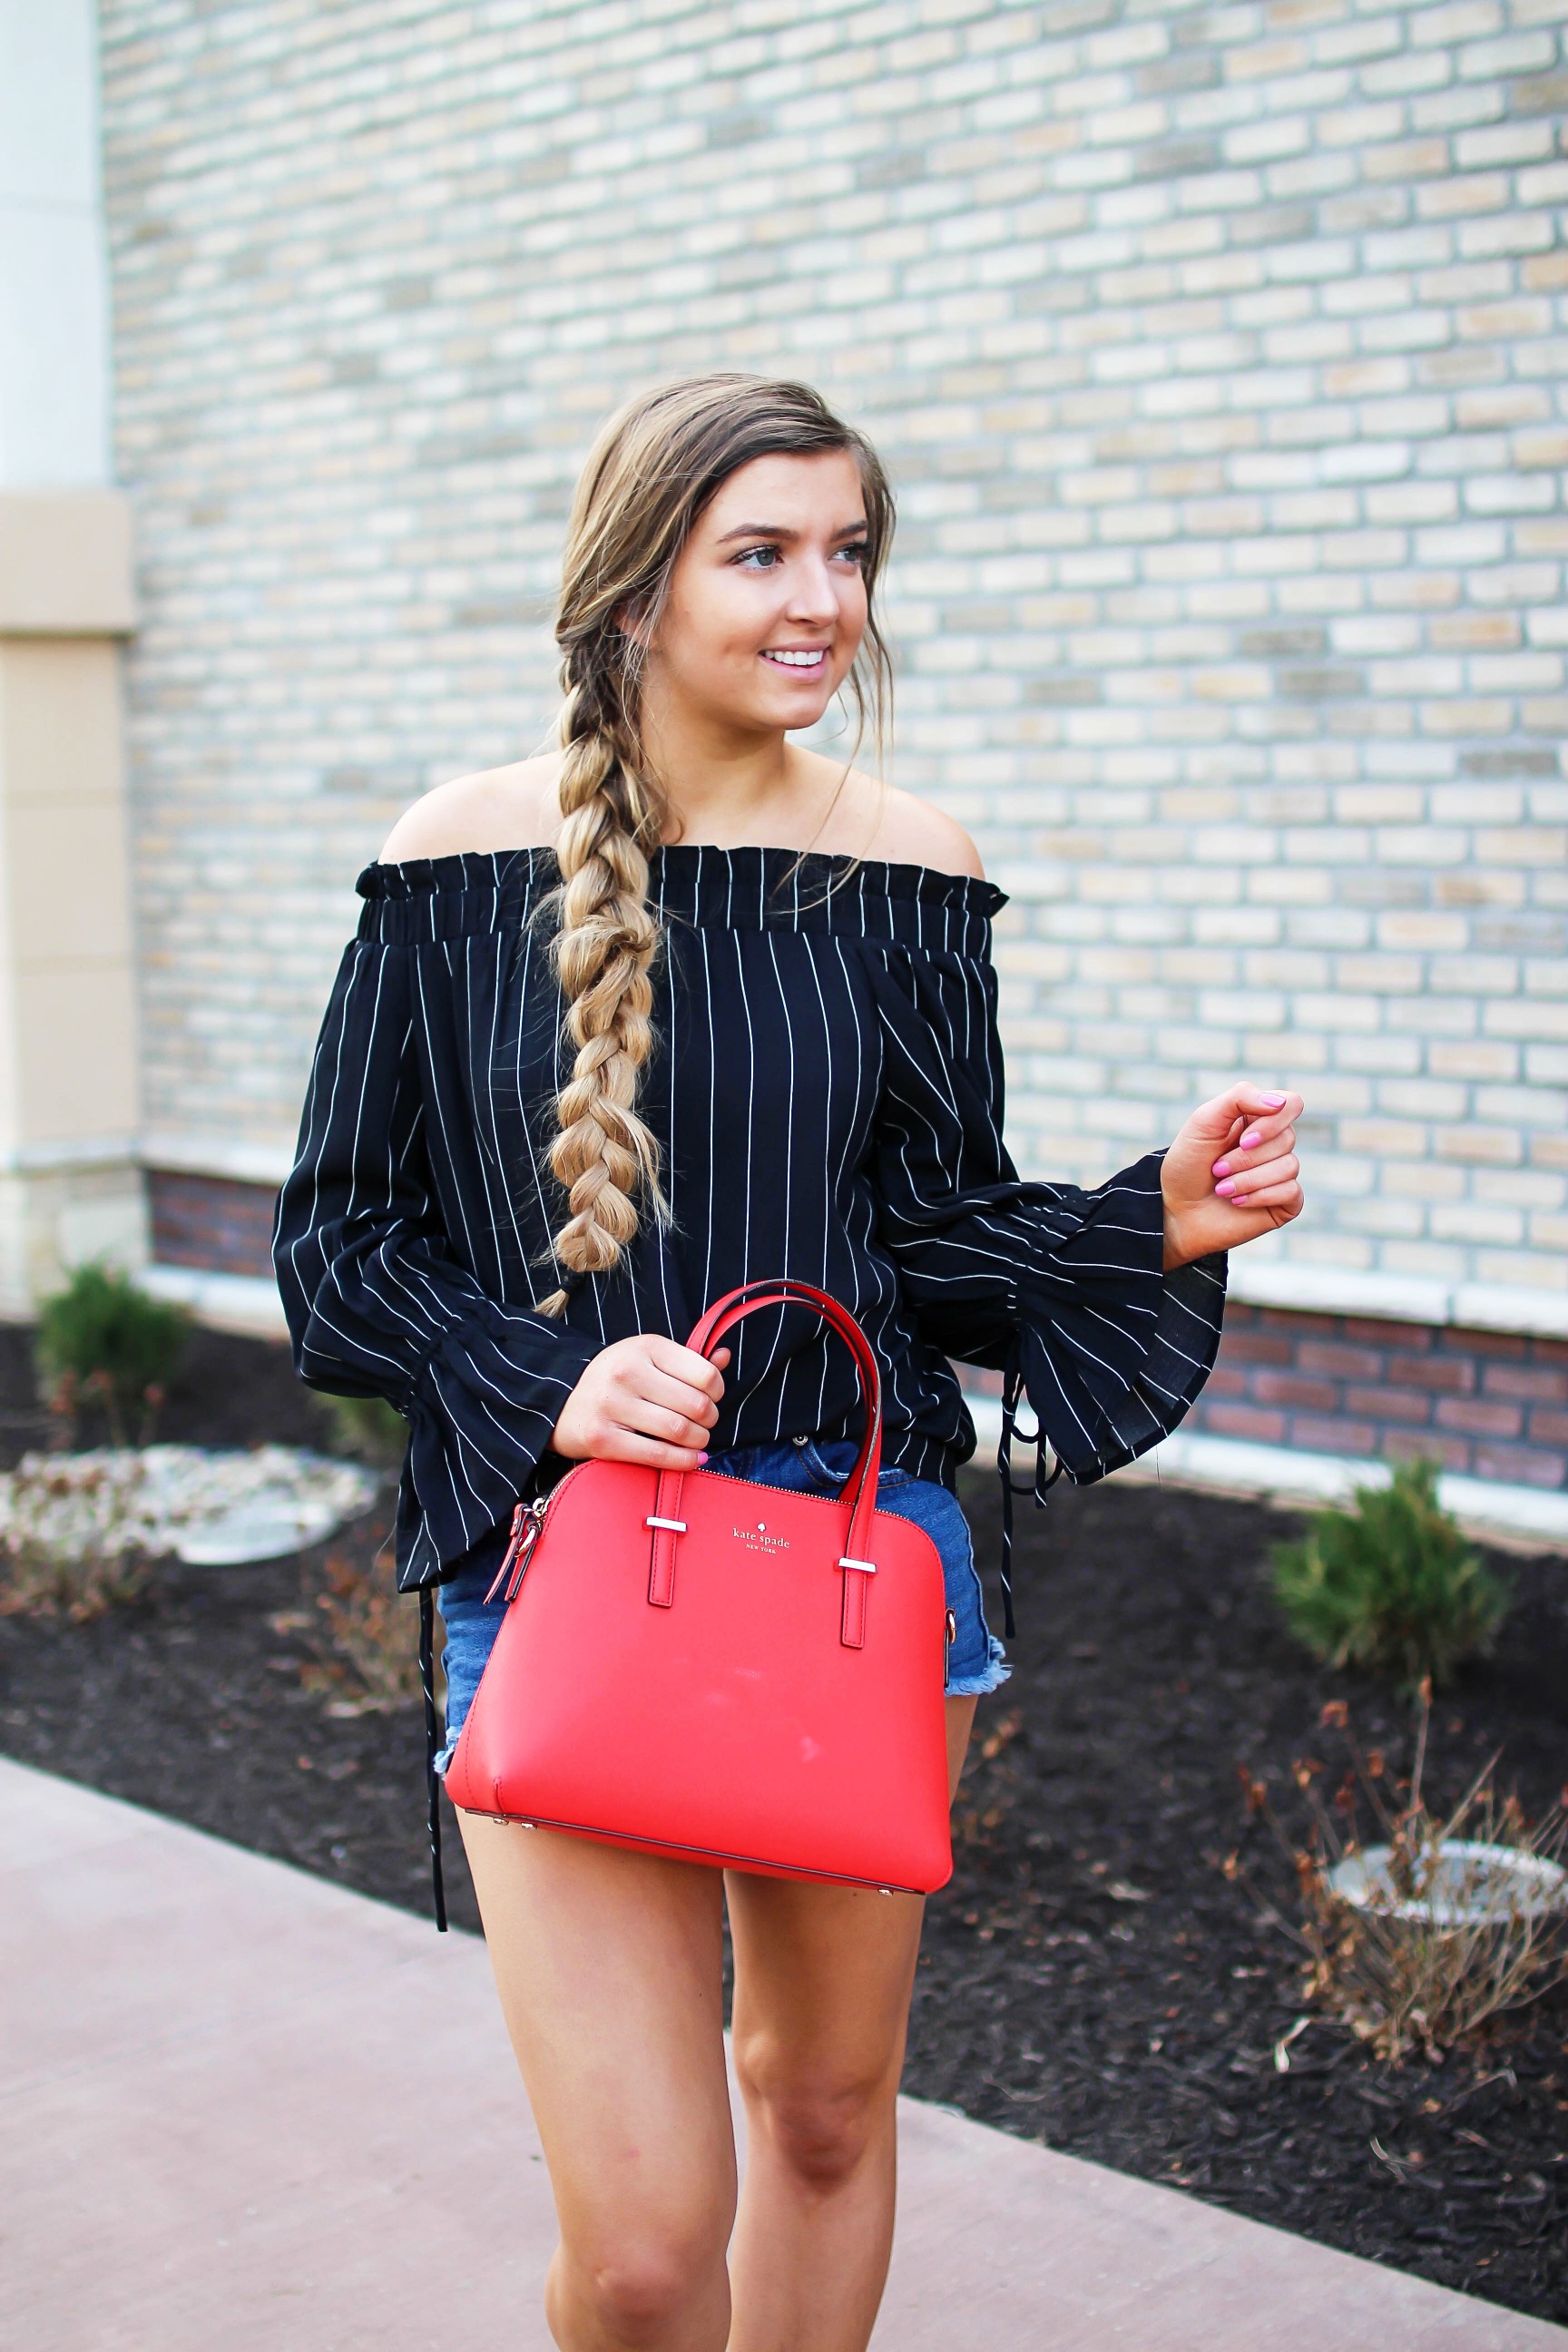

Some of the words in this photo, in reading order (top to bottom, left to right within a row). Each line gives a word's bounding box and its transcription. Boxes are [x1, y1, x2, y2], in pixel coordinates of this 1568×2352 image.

[733, 1528, 756, 1541] kate
[760, 1535, 789, 1548] spade
[760, 1546, 776, 1554] YORK
